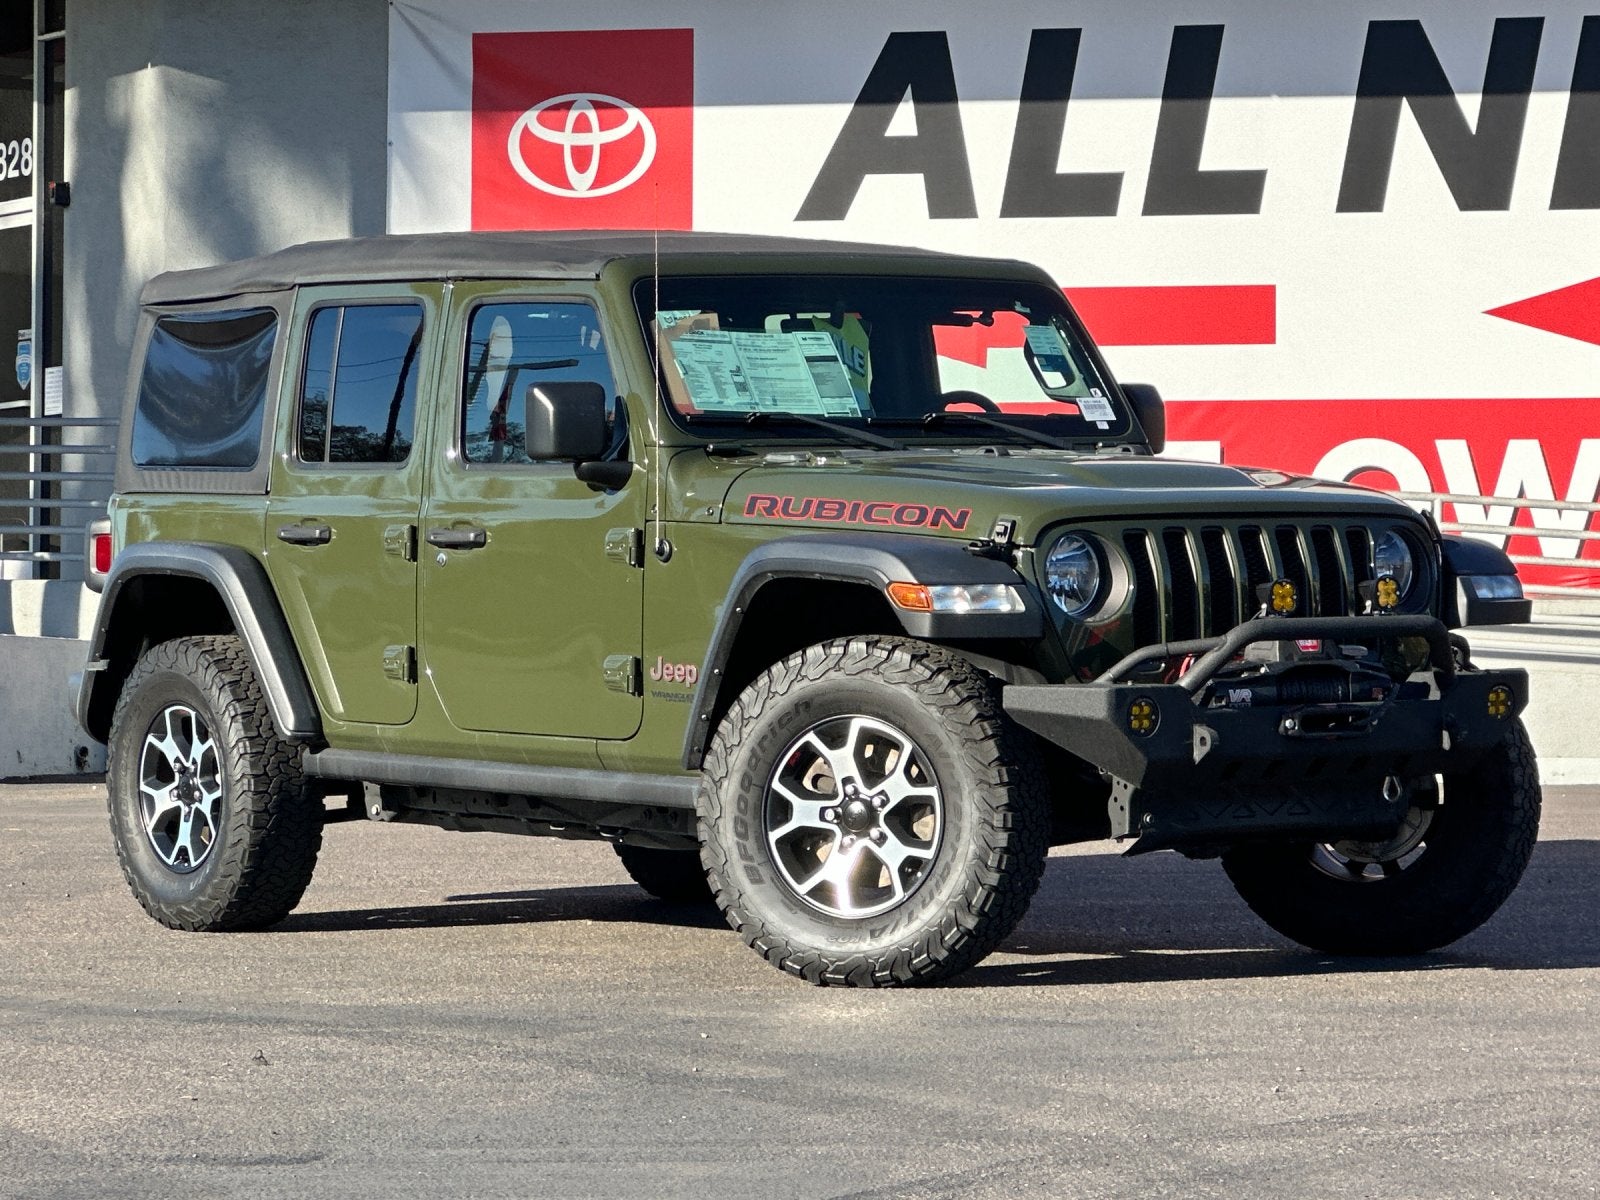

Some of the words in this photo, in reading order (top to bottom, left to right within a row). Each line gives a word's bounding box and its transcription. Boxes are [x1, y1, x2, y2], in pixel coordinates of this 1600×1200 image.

[794, 24, 1268, 221] ALL
[744, 494, 972, 531] RUBICON
[650, 656, 699, 688] Jeep
[733, 699, 813, 887] BFGoodrich
